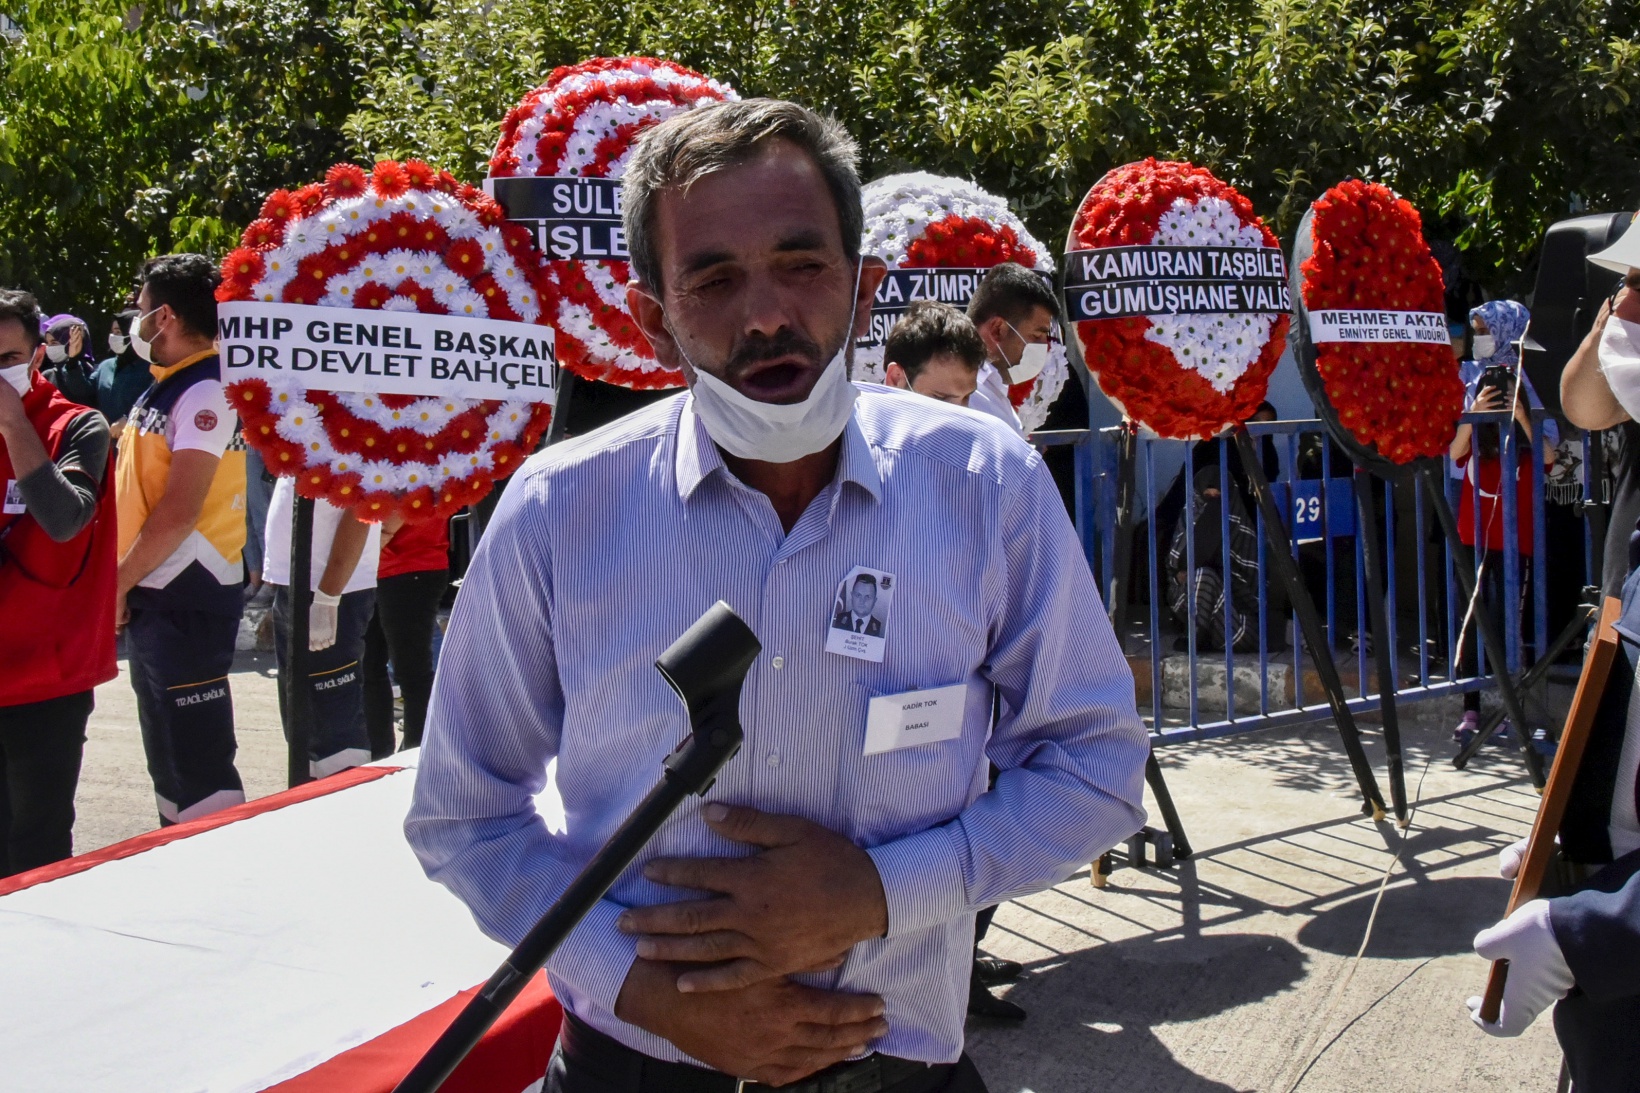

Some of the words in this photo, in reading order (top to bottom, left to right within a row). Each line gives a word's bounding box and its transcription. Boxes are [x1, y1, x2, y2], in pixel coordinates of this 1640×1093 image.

[524, 220, 630, 261] İŞLE
[1082, 251, 1203, 281] KAMURAN
[1081, 280, 1239, 316] GÜMÜŞHANE
[1242, 280, 1292, 311] VALİS
[1321, 312, 1399, 326] MEHMET
[218, 316, 293, 340] MHP
[306, 320, 422, 350] GENEL
[434, 329, 555, 363] BAŞKAN
[1339, 326, 1379, 339] EMNİYET
[1382, 328, 1411, 340] GENEL
[1415, 328, 1446, 342] MÜDÜRÜ
[227, 344, 283, 370] DR
[291, 347, 422, 377] DEVLET
[431, 357, 555, 390] BAHÇELİ
[1296, 496, 1320, 523] 29
[902, 701, 923, 711] KADİR
[924, 699, 938, 708] TOK
[905, 721, 929, 731] BABASI
